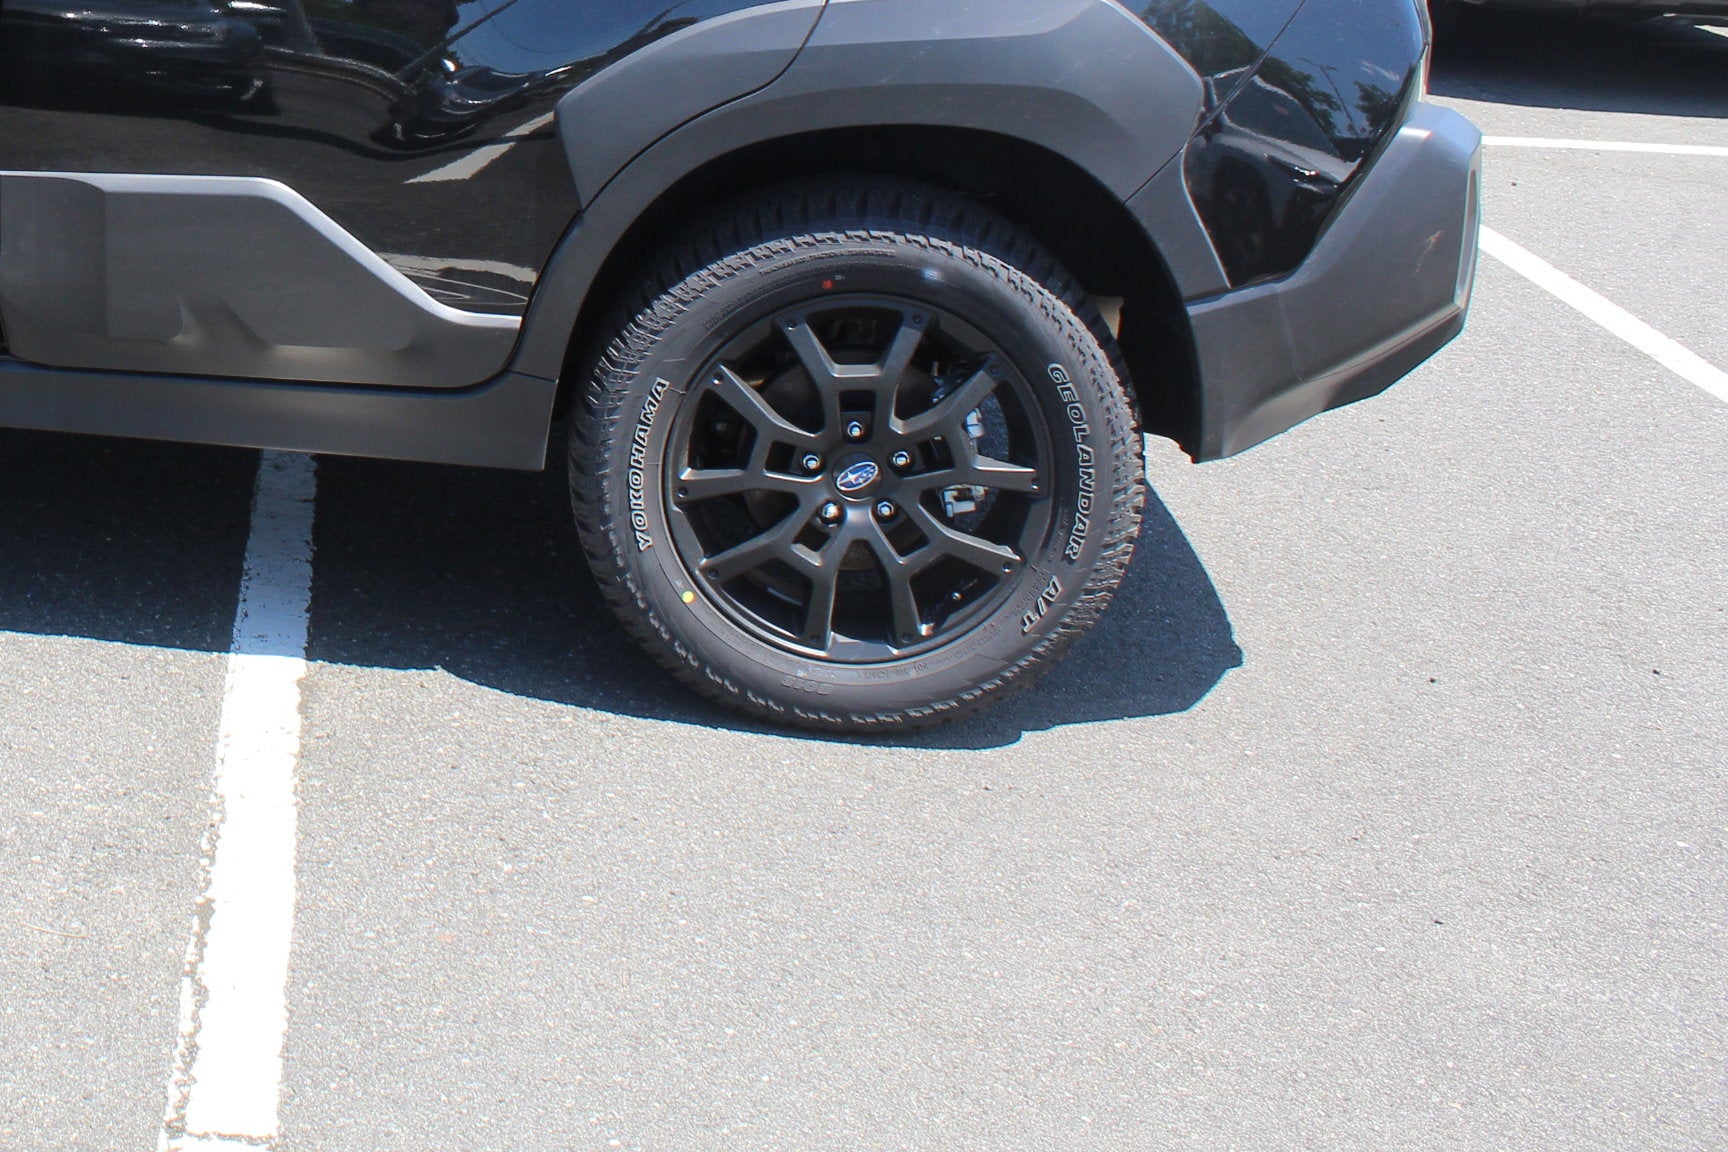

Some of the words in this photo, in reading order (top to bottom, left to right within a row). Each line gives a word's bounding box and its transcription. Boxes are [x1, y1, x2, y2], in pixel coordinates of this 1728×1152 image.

[628, 376, 671, 552] YOKOHAMA
[1047, 362, 1095, 561] GEOLANDAR
[1022, 574, 1063, 634] A/T
